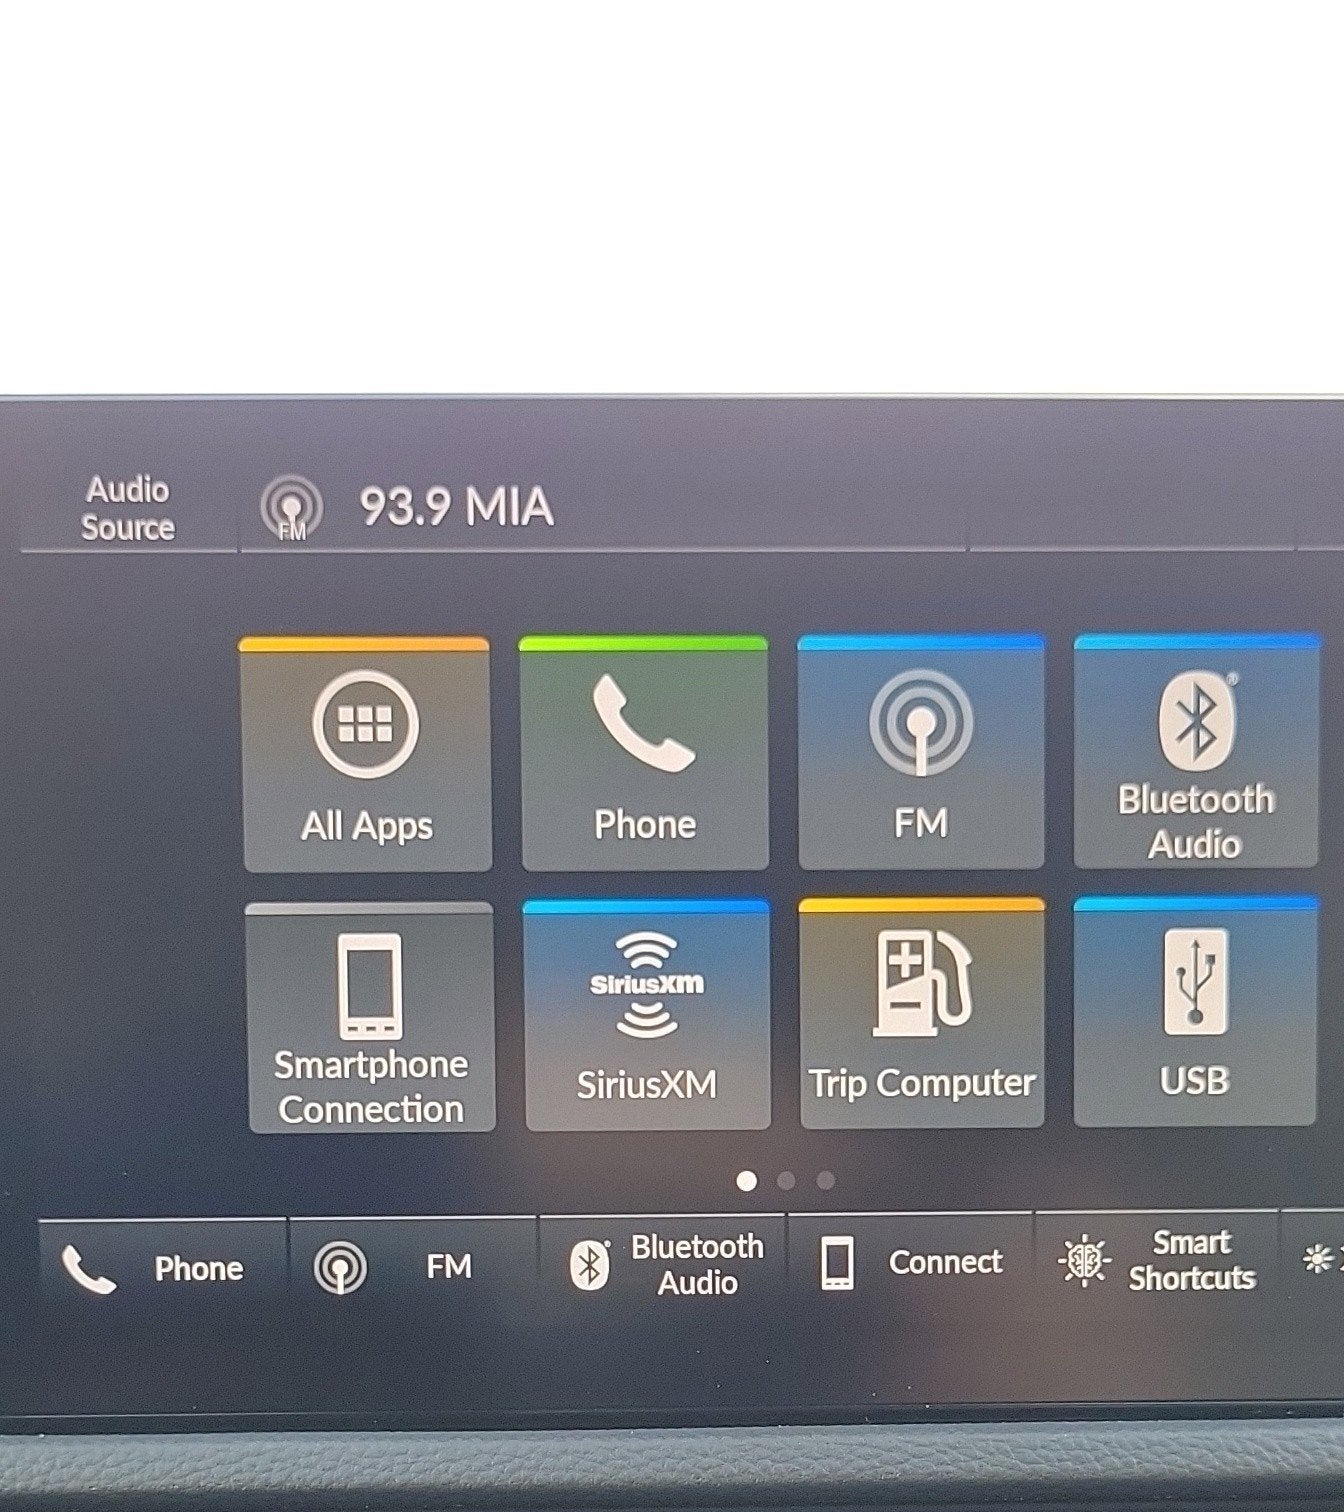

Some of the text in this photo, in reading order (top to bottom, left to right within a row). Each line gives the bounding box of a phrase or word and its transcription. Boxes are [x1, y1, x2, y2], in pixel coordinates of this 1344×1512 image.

[86, 475, 170, 504] Audio
[360, 485, 555, 527] 93.9 MIA
[81, 513, 176, 541] Source
[279, 523, 307, 541] FM
[1118, 783, 1275, 815] Bluetooth
[301, 811, 434, 846] All Apps
[594, 808, 697, 840] Phone
[895, 807, 949, 838] FM
[1147, 829, 1242, 860] Audio
[273, 1050, 469, 1088] Smartphone
[1159, 1066, 1231, 1095] USB
[577, 1069, 718, 1101] SiriusXM
[808, 1068, 1036, 1103] Trip Computer
[278, 1094, 464, 1125] Connection
[631, 1233, 765, 1261] Bluetooth
[1153, 1229, 1233, 1256] Smart
[155, 1255, 244, 1283] Phone
[426, 1253, 473, 1280] FM
[888, 1249, 1004, 1276] Connect
[657, 1271, 739, 1297] Audio
[1129, 1263, 1257, 1292] Shortcuts
